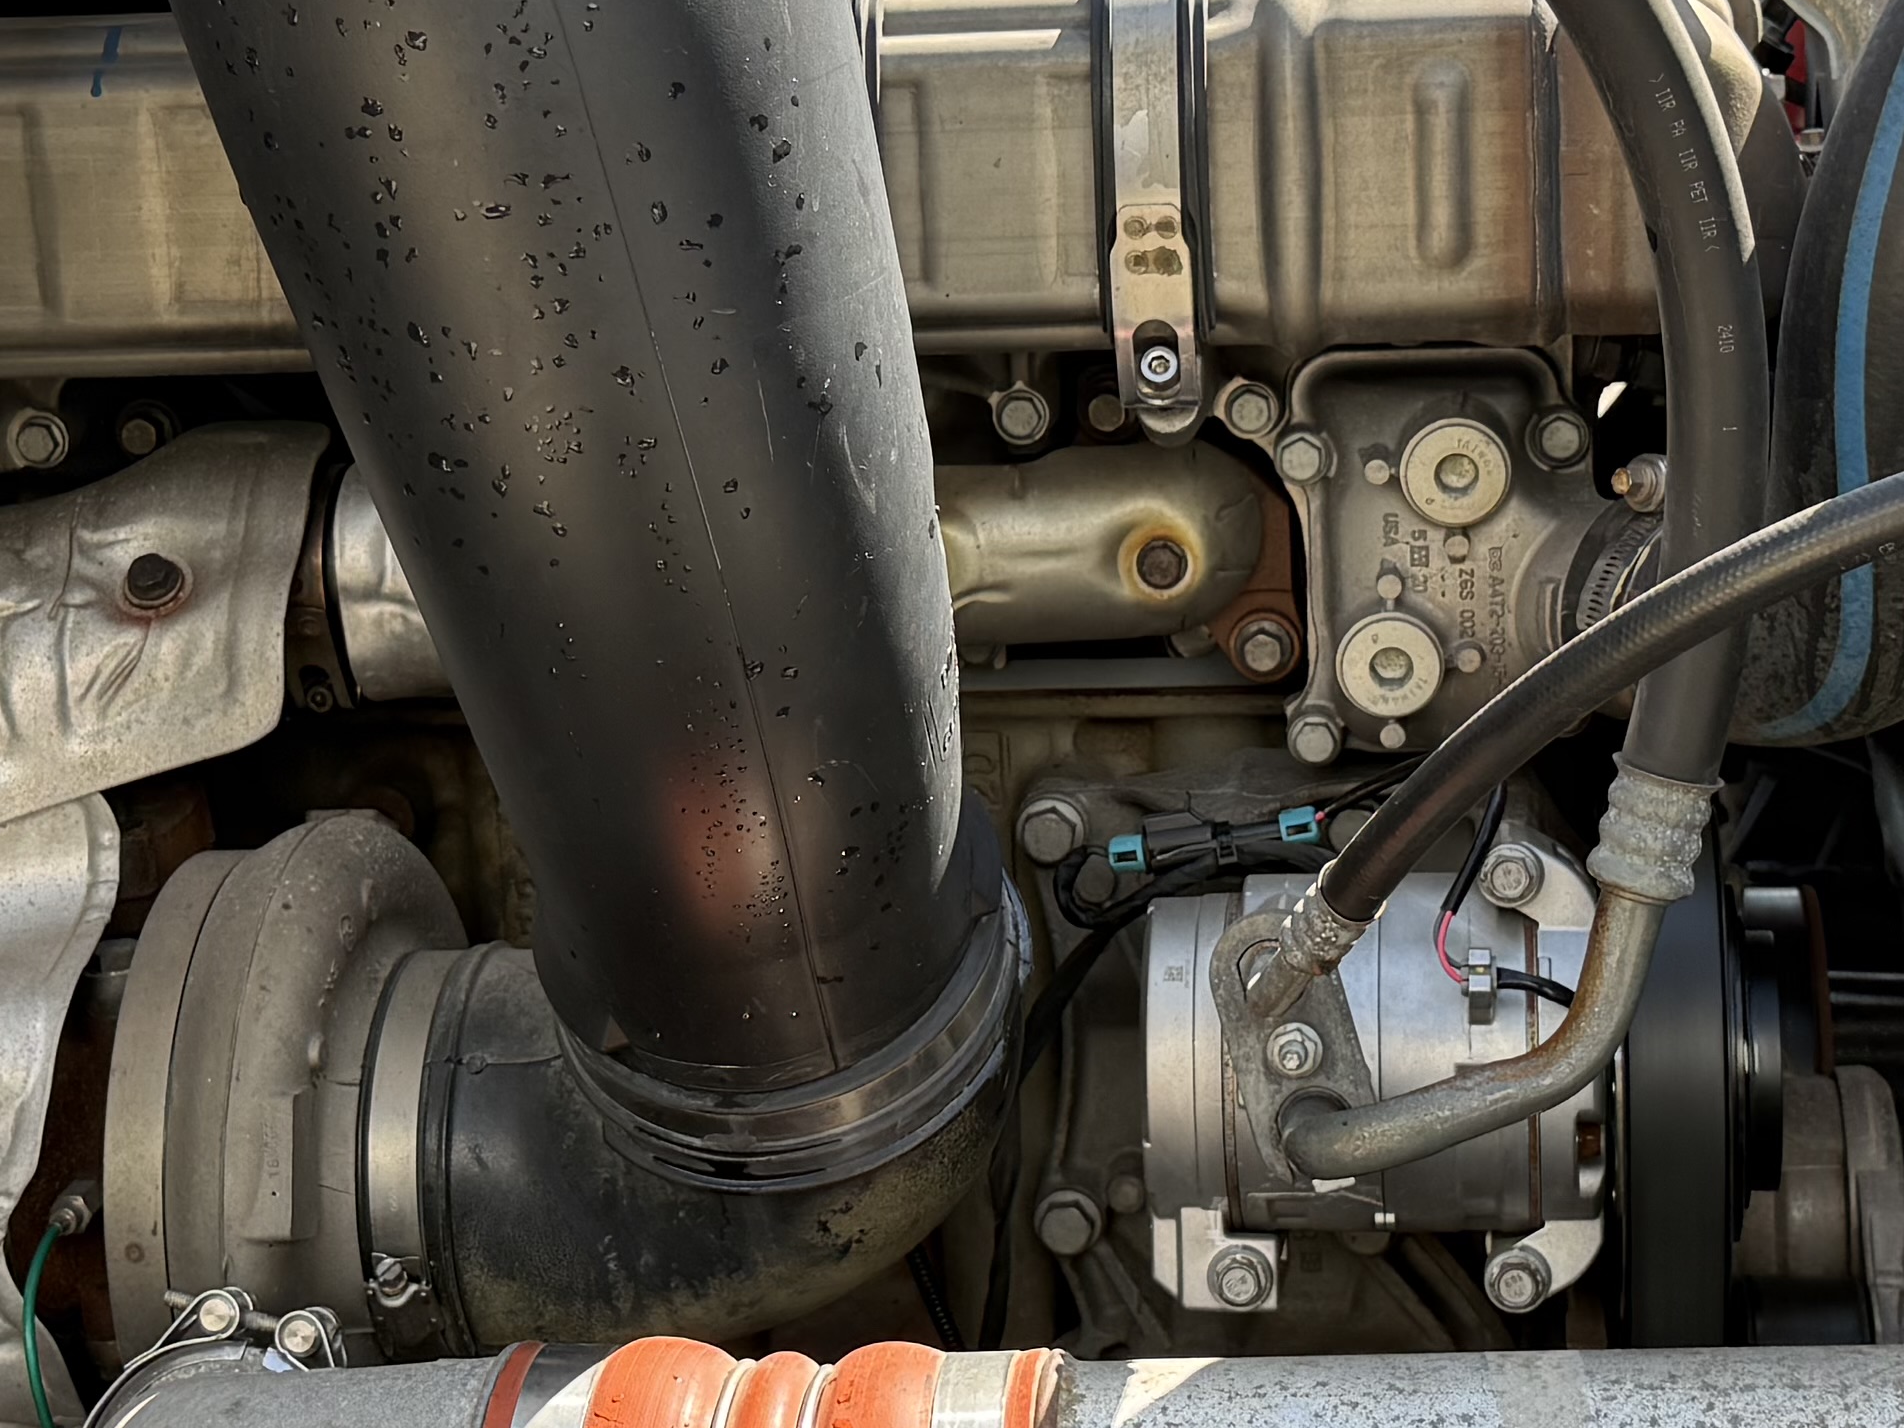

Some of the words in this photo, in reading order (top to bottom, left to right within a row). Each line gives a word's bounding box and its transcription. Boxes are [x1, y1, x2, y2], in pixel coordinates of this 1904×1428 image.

[1668, 118, 1687, 138] PA
[1687, 180, 1709, 205] PET
[1716, 324, 1734, 353] 2410
[1381, 512, 1400, 547] USA
